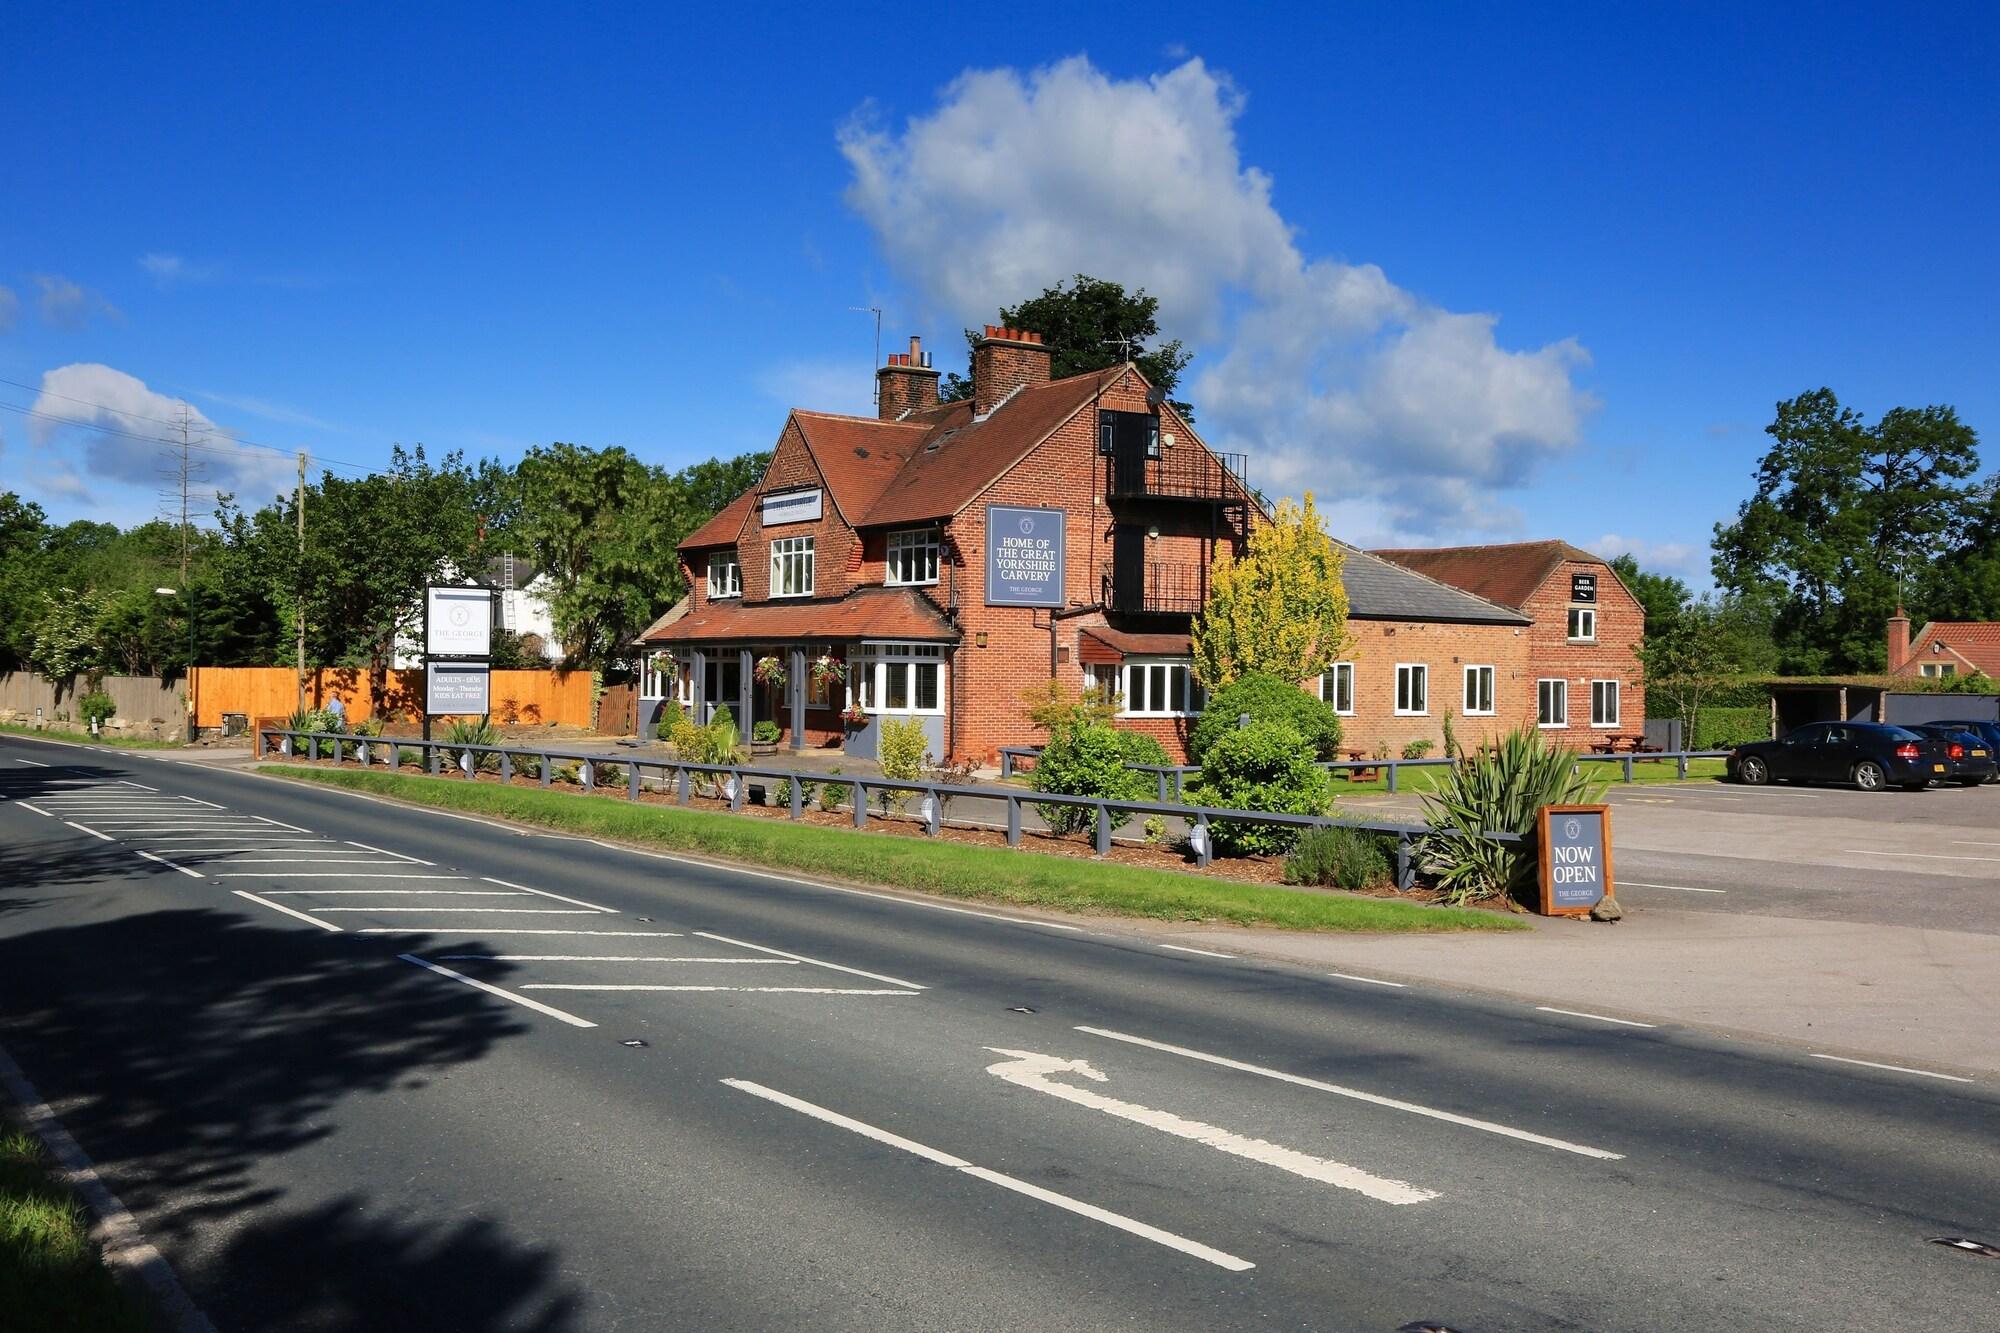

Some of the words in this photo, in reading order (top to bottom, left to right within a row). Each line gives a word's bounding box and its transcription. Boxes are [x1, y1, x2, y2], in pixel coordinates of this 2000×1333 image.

[1003, 537, 1034, 548] HOME
[1036, 539, 1050, 549] OF
[996, 548, 1018, 558] THE
[1020, 549, 1056, 560] GREAT
[996, 559, 1056, 571] YORKSHIRE
[1001, 570, 1051, 581] CARVERY
[434, 629, 450, 637] THE
[1554, 846, 1594, 863] NOW
[1553, 866, 1597, 883] OPEN
